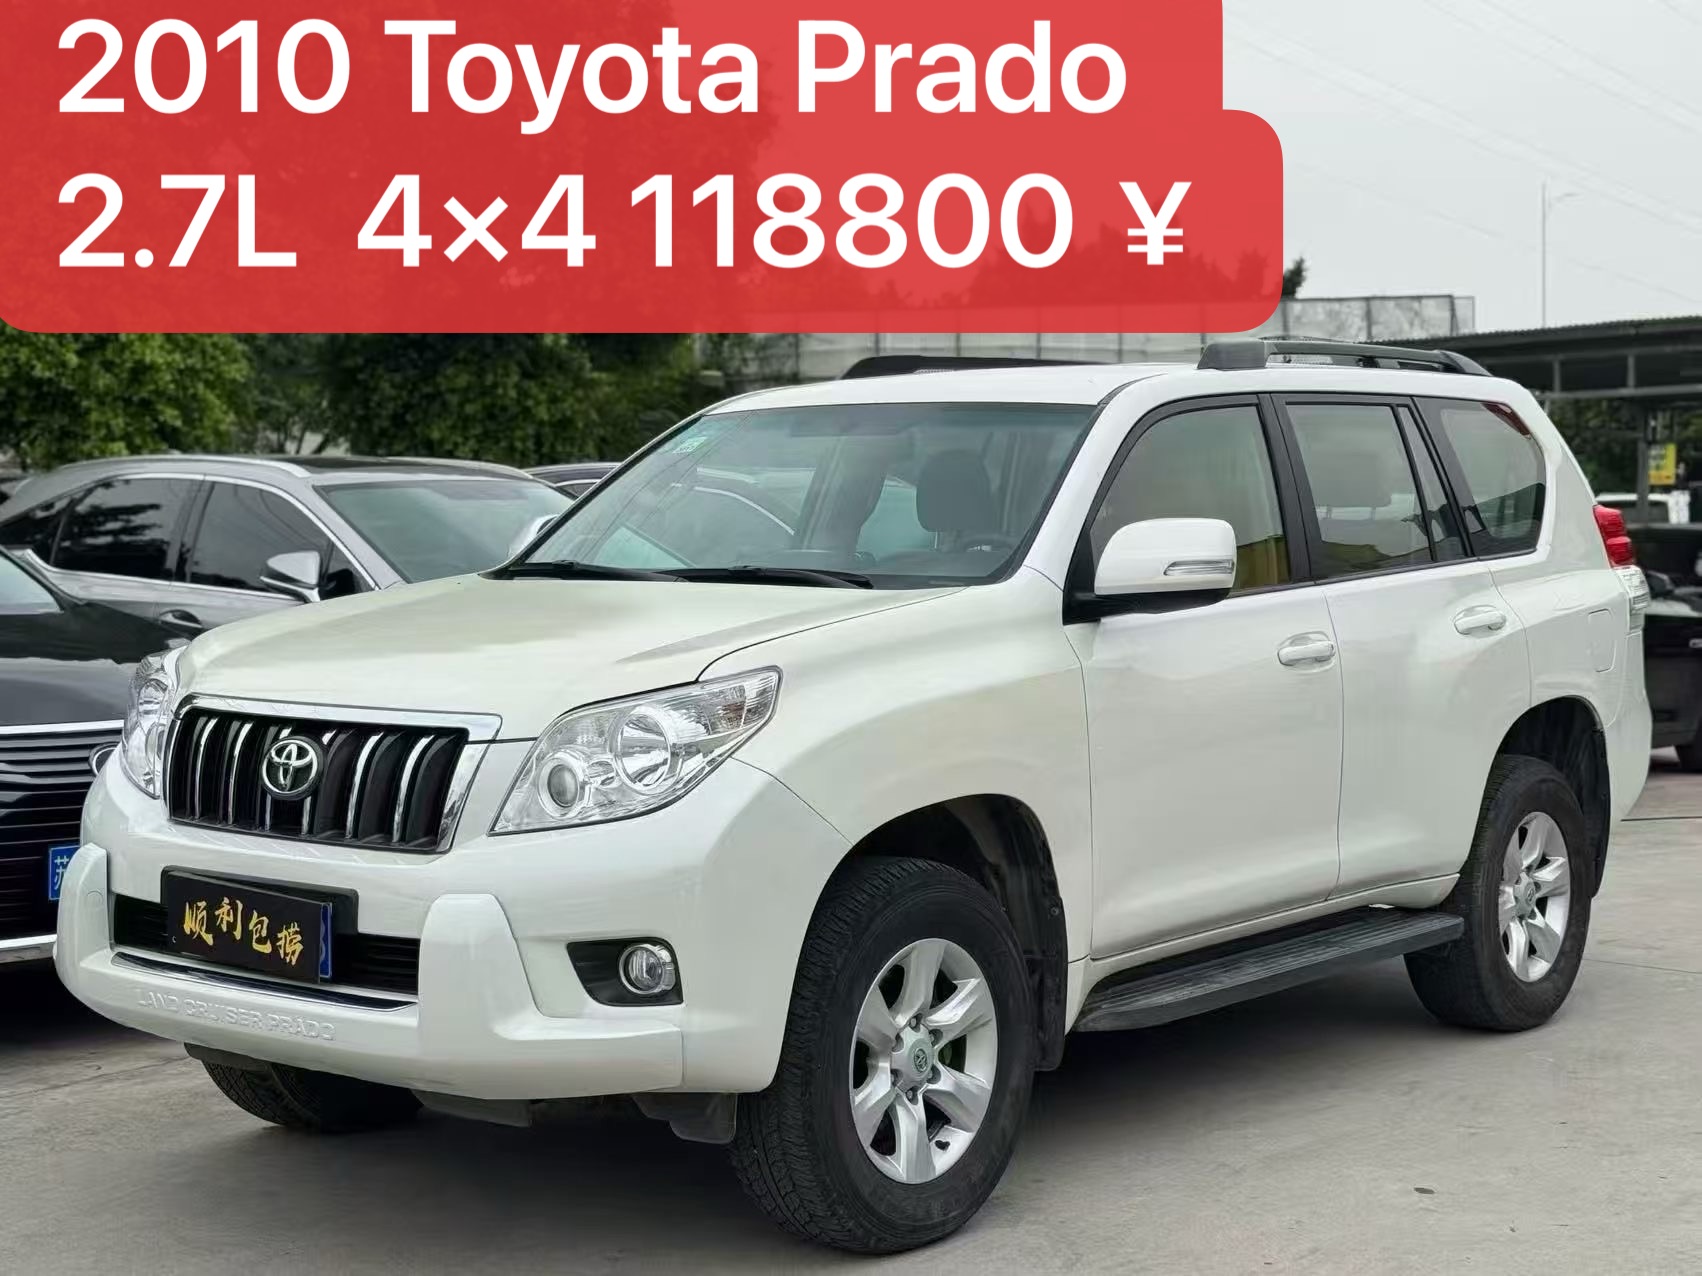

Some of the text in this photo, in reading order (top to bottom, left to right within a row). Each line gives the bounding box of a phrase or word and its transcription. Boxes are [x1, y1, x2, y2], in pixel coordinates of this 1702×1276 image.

[183, 896, 305, 967] 顺利包捞
[265, 1012, 337, 1042] PRADO
